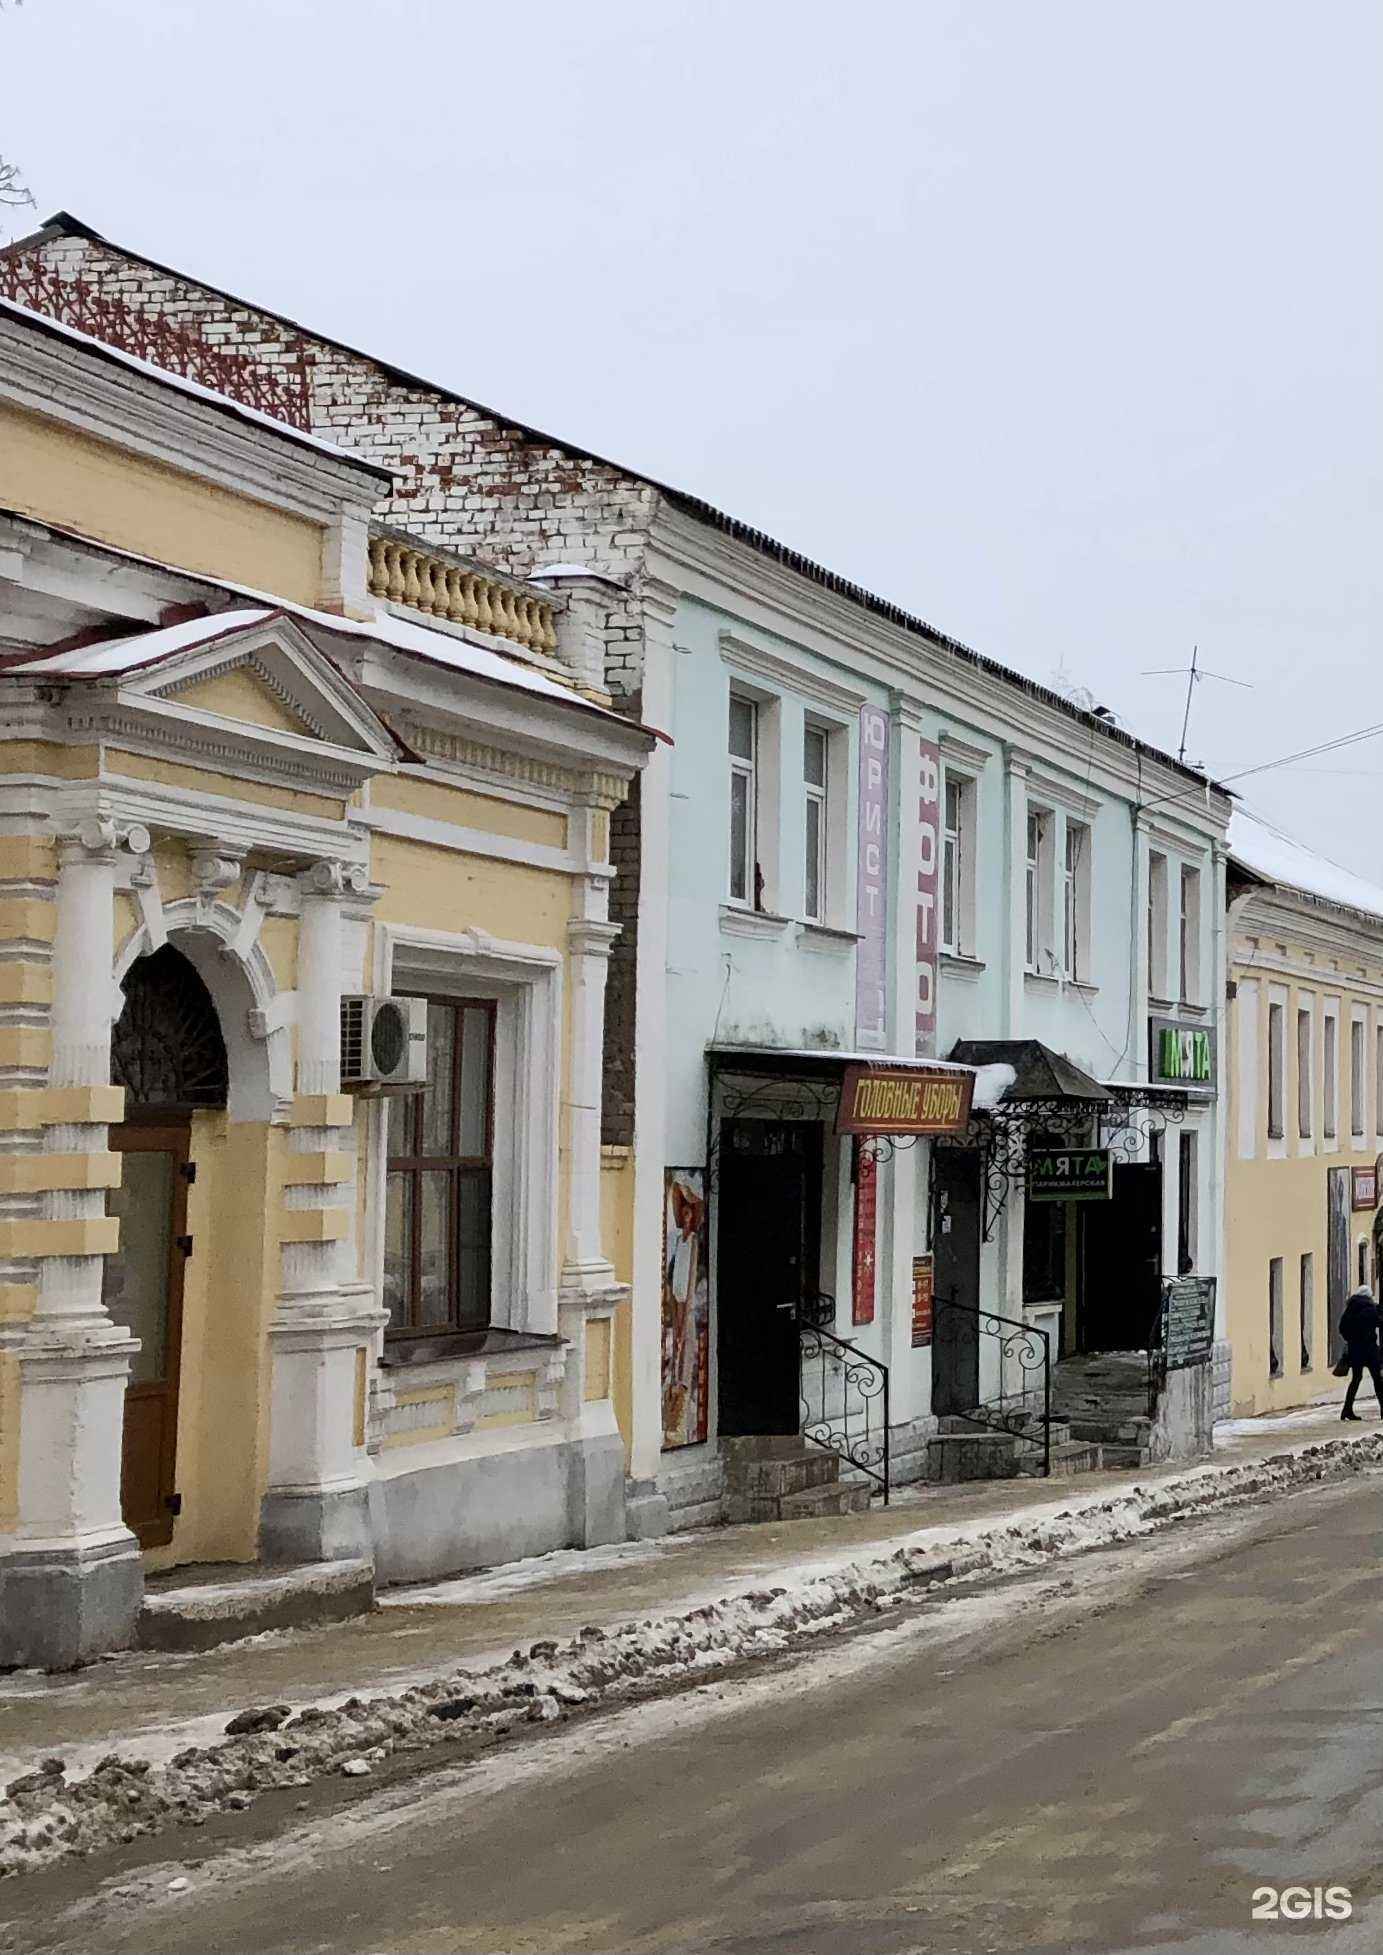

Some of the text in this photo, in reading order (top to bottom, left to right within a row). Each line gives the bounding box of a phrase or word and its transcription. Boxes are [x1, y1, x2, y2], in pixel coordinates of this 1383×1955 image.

[863, 713, 886, 916] ЮРИСТ
[914, 753, 938, 1015] ФОТО
[852, 1079, 963, 1124] ГОЛОВНЫЕ УБОРЫ
[1162, 1028, 1211, 1080] МЯТА
